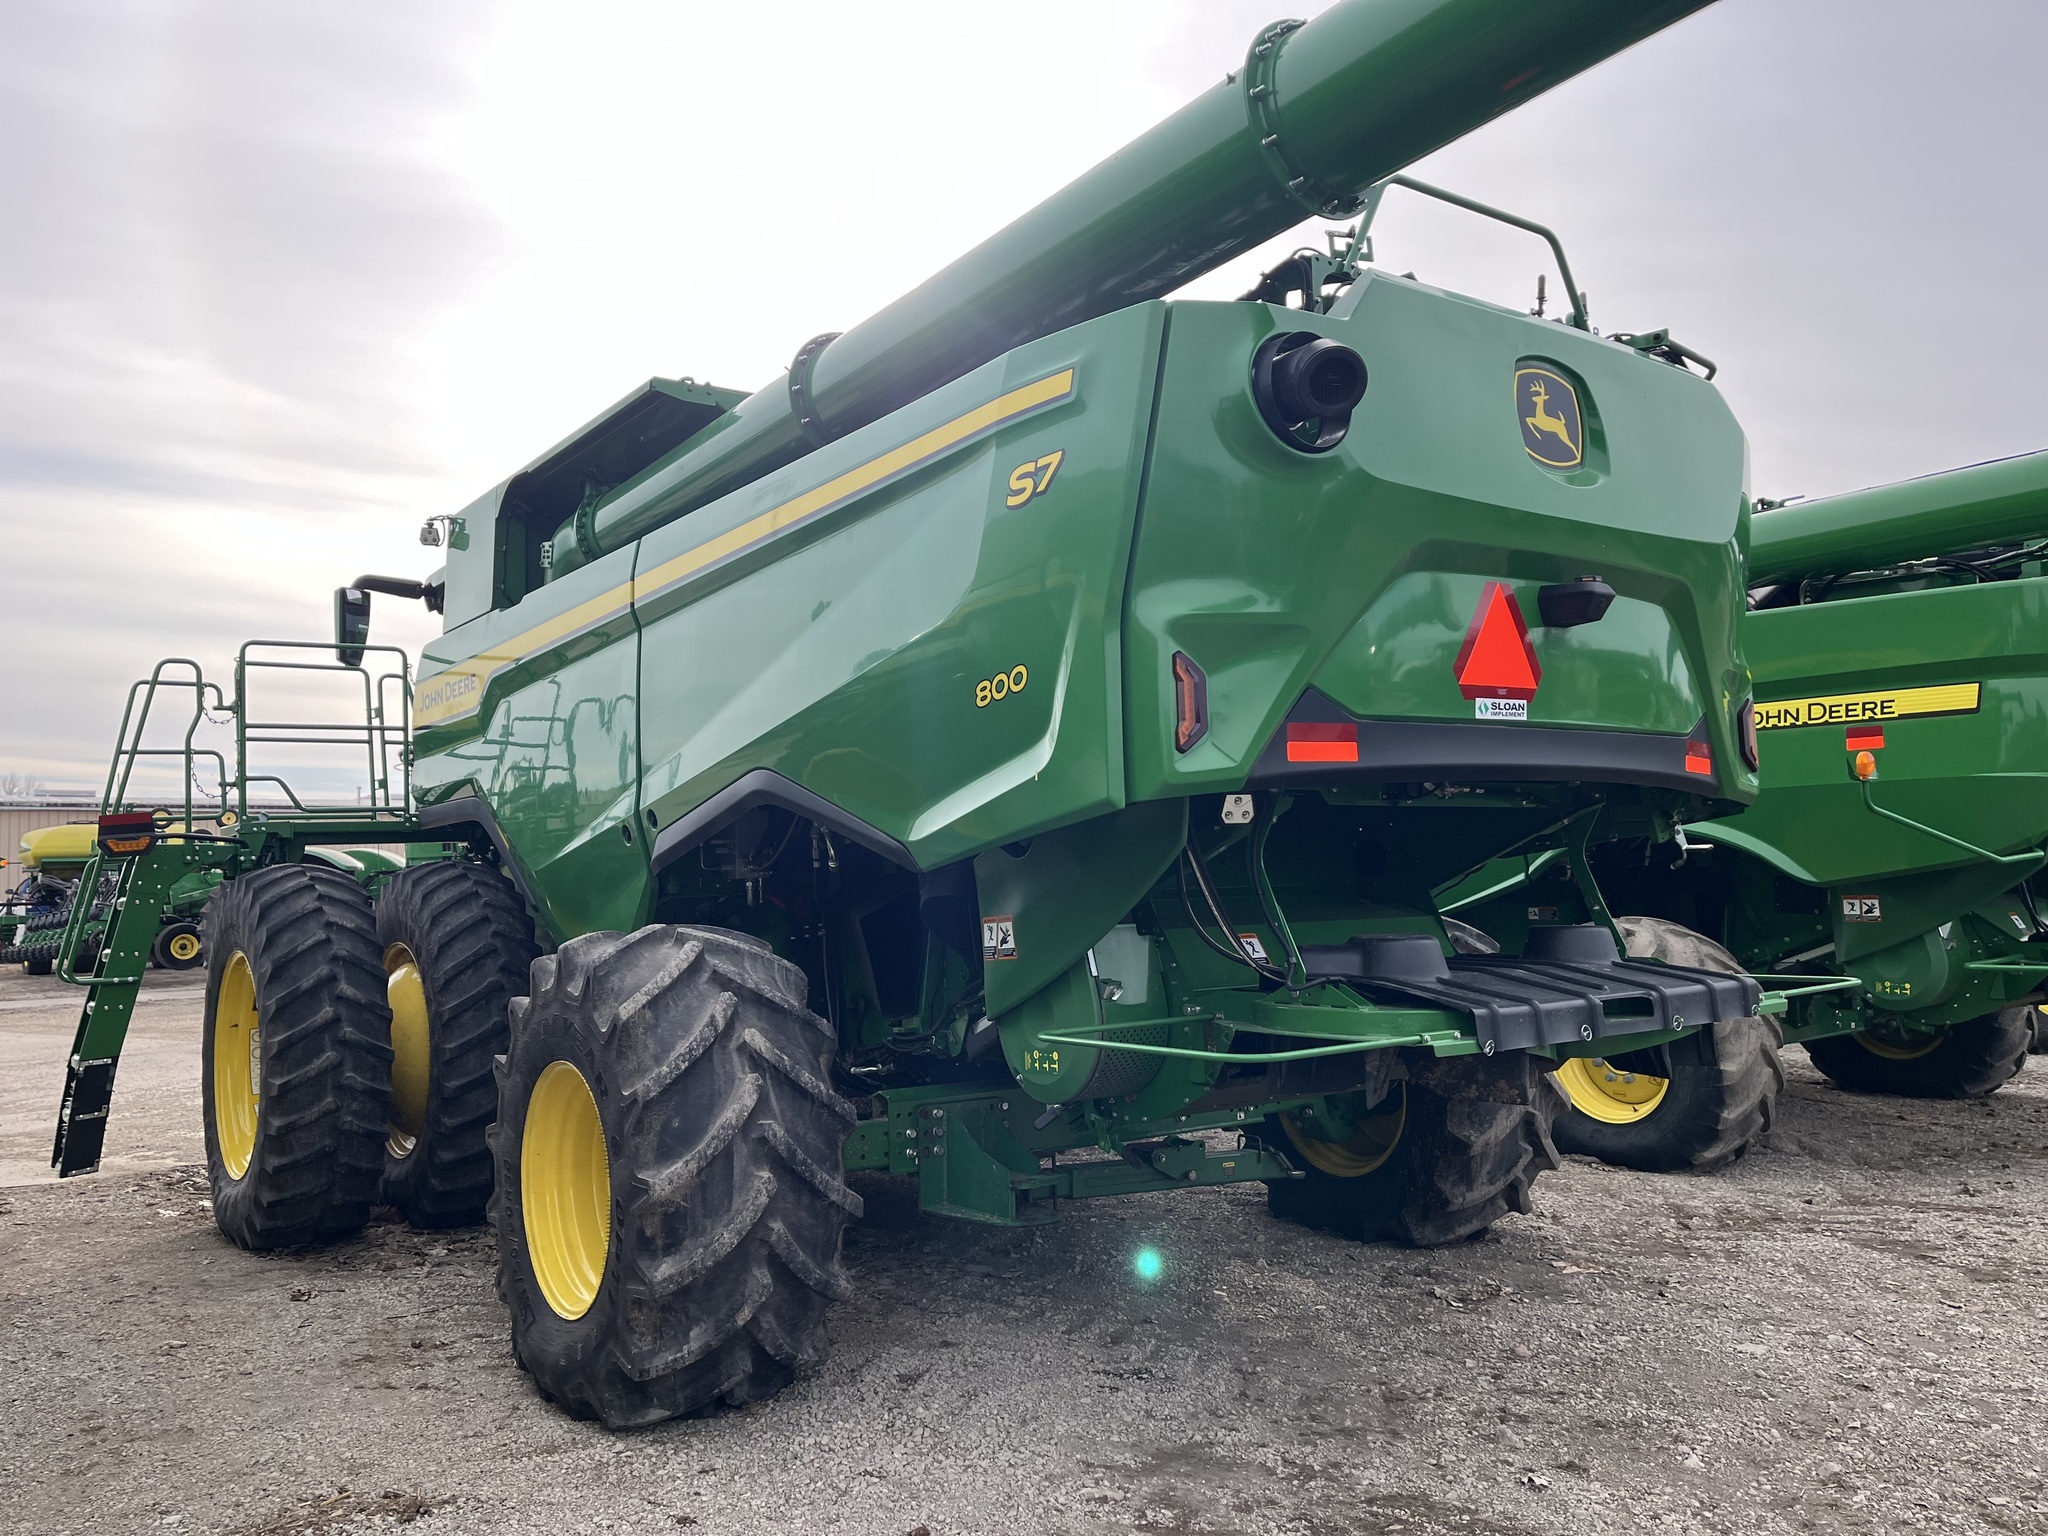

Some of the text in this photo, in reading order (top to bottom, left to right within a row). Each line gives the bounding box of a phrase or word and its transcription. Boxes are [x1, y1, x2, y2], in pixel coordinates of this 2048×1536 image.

[1006, 448, 1066, 510] S7
[419, 675, 477, 713] JOHN DEERE
[975, 664, 1028, 708] 800
[1490, 701, 1525, 712] SLOAN
[1754, 699, 1896, 726] OHN DEERE
